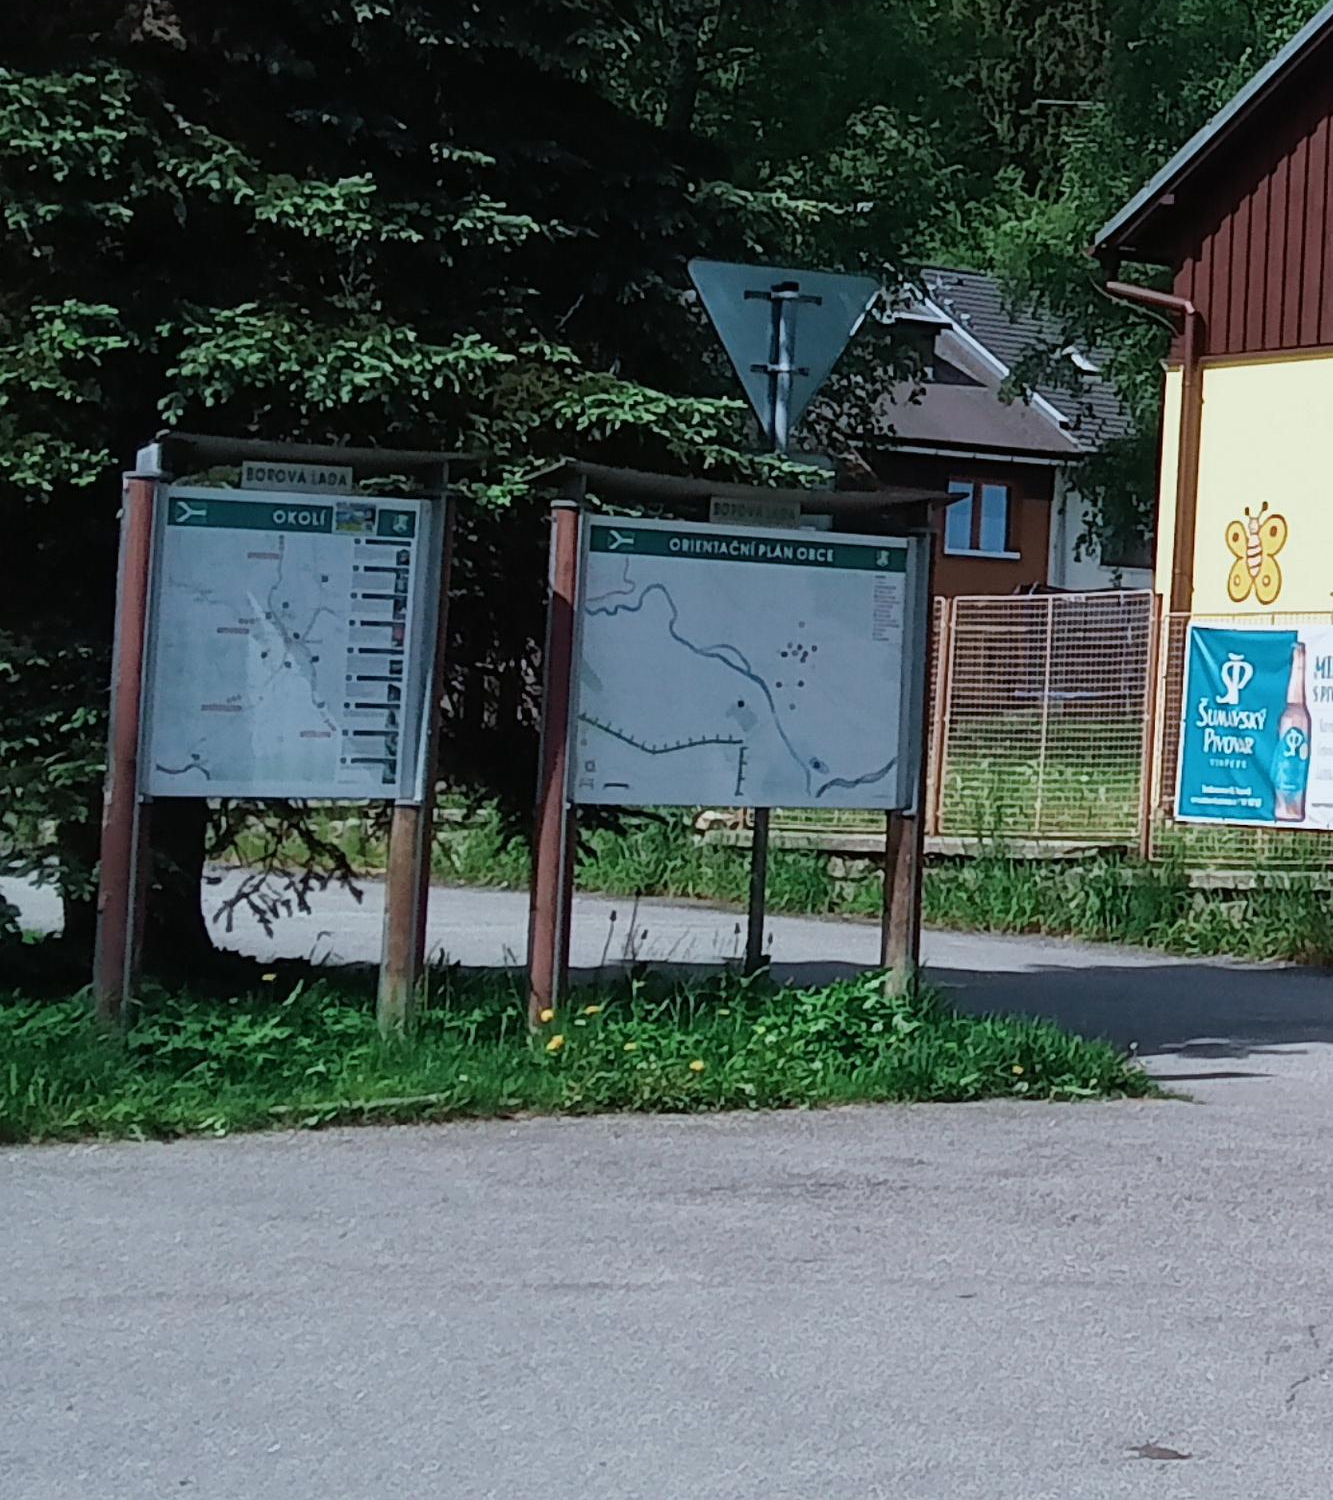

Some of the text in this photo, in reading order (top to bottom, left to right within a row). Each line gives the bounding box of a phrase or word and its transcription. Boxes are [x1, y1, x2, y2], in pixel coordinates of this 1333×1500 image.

[272, 508, 326, 526] OKOLÍ
[669, 536, 834, 562] ORIENTAČNÍ PLÁN OBCE
